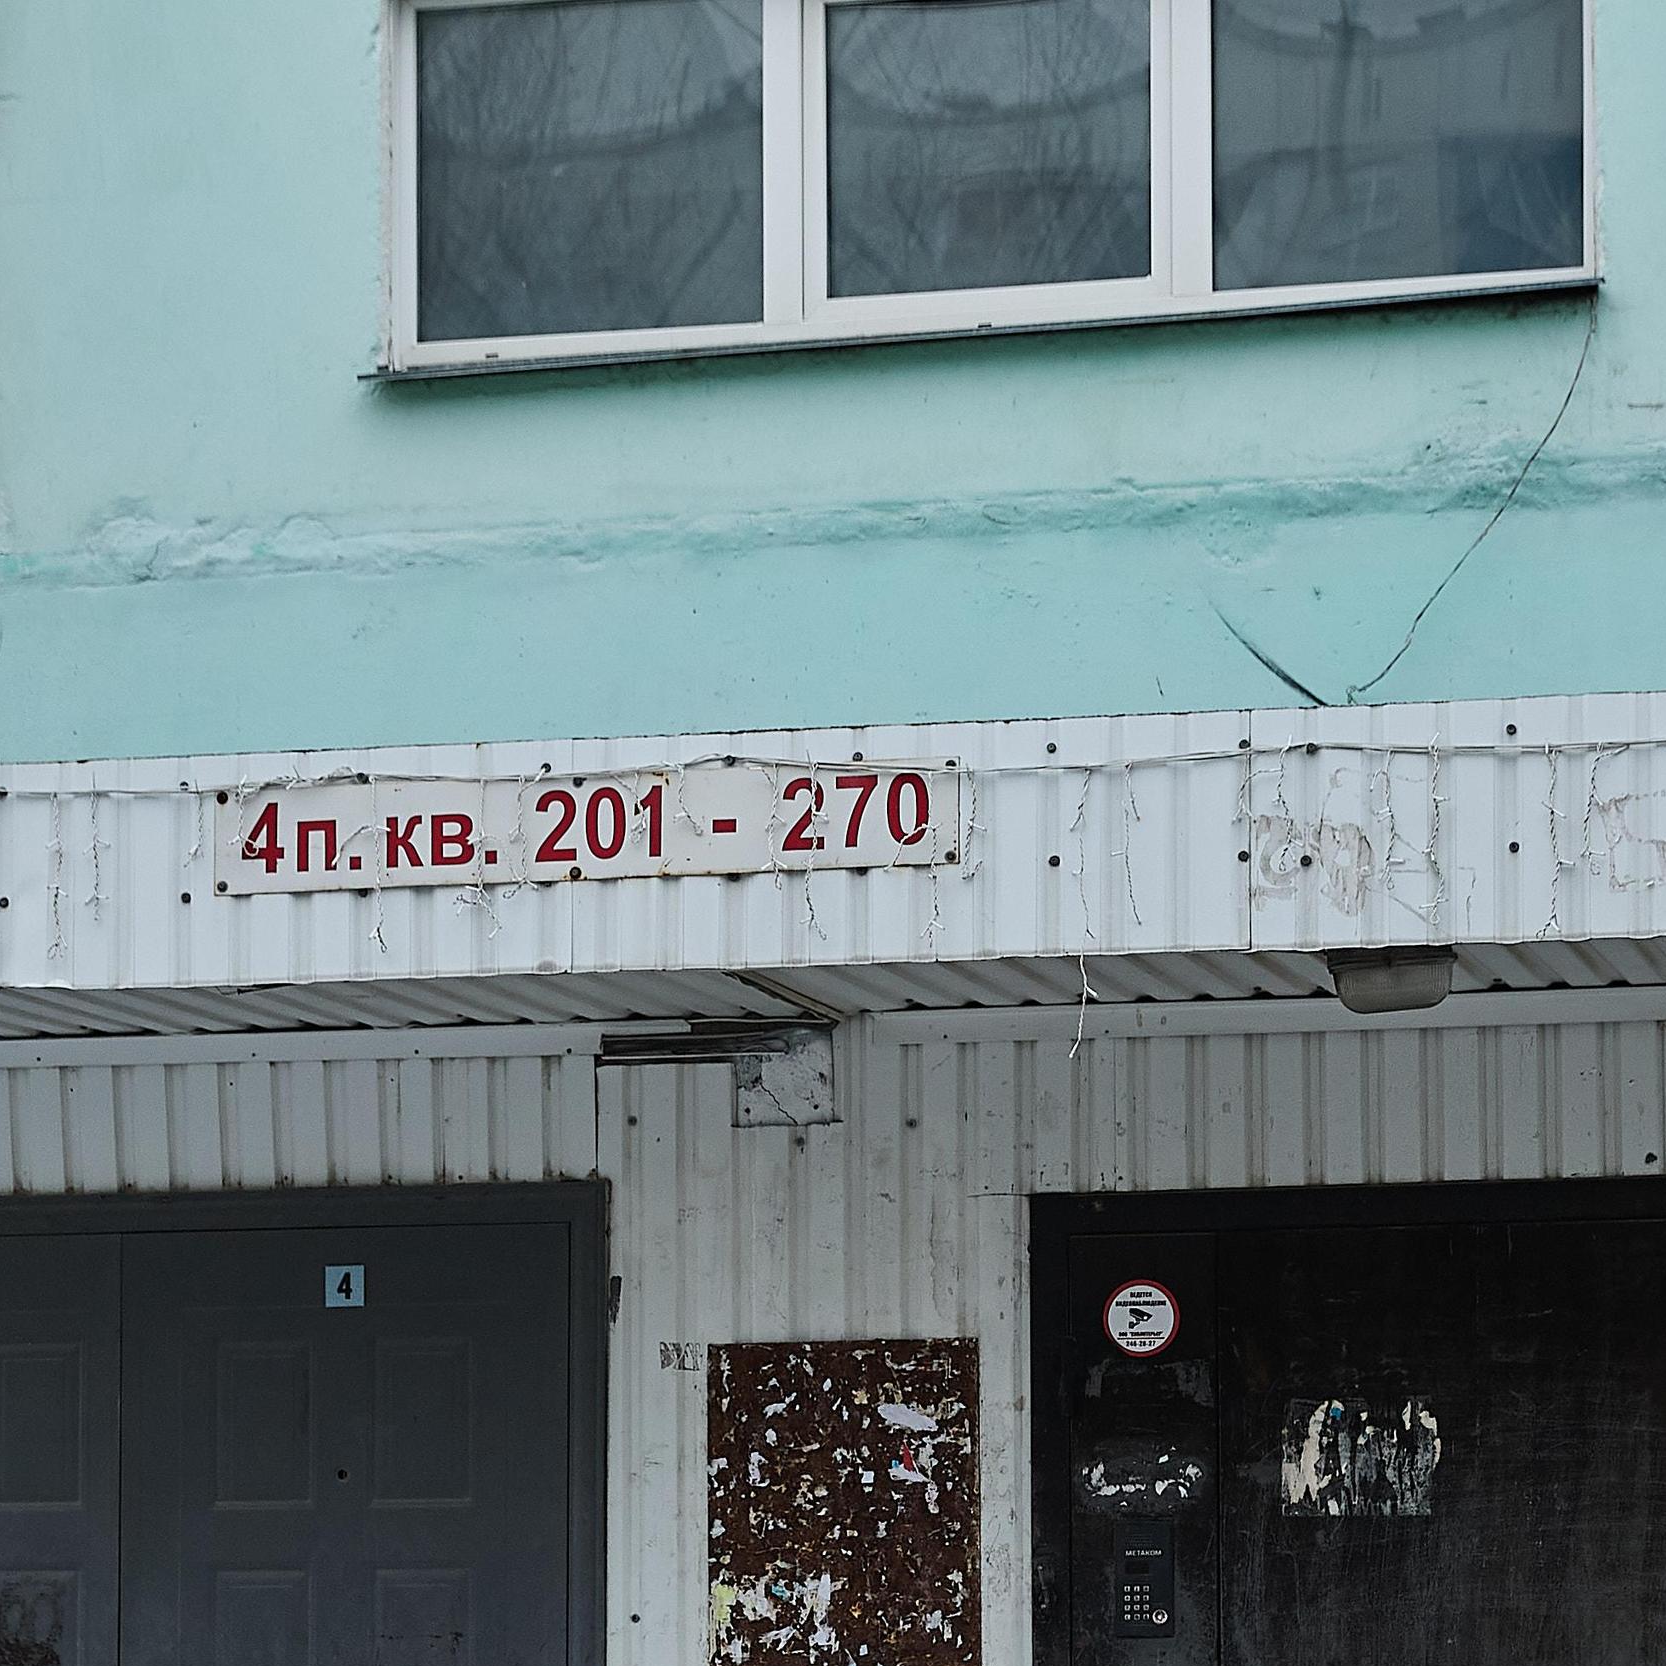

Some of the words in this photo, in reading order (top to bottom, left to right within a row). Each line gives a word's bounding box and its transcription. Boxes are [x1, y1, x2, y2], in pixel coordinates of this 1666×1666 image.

[241, 802, 362, 873] 4п.
[386, 815, 499, 868] кв.
[535, 785, 663, 864] 201
[712, 819, 738, 835] -
[782, 773, 930, 852] 270
[336, 1271, 353, 1300] 4
